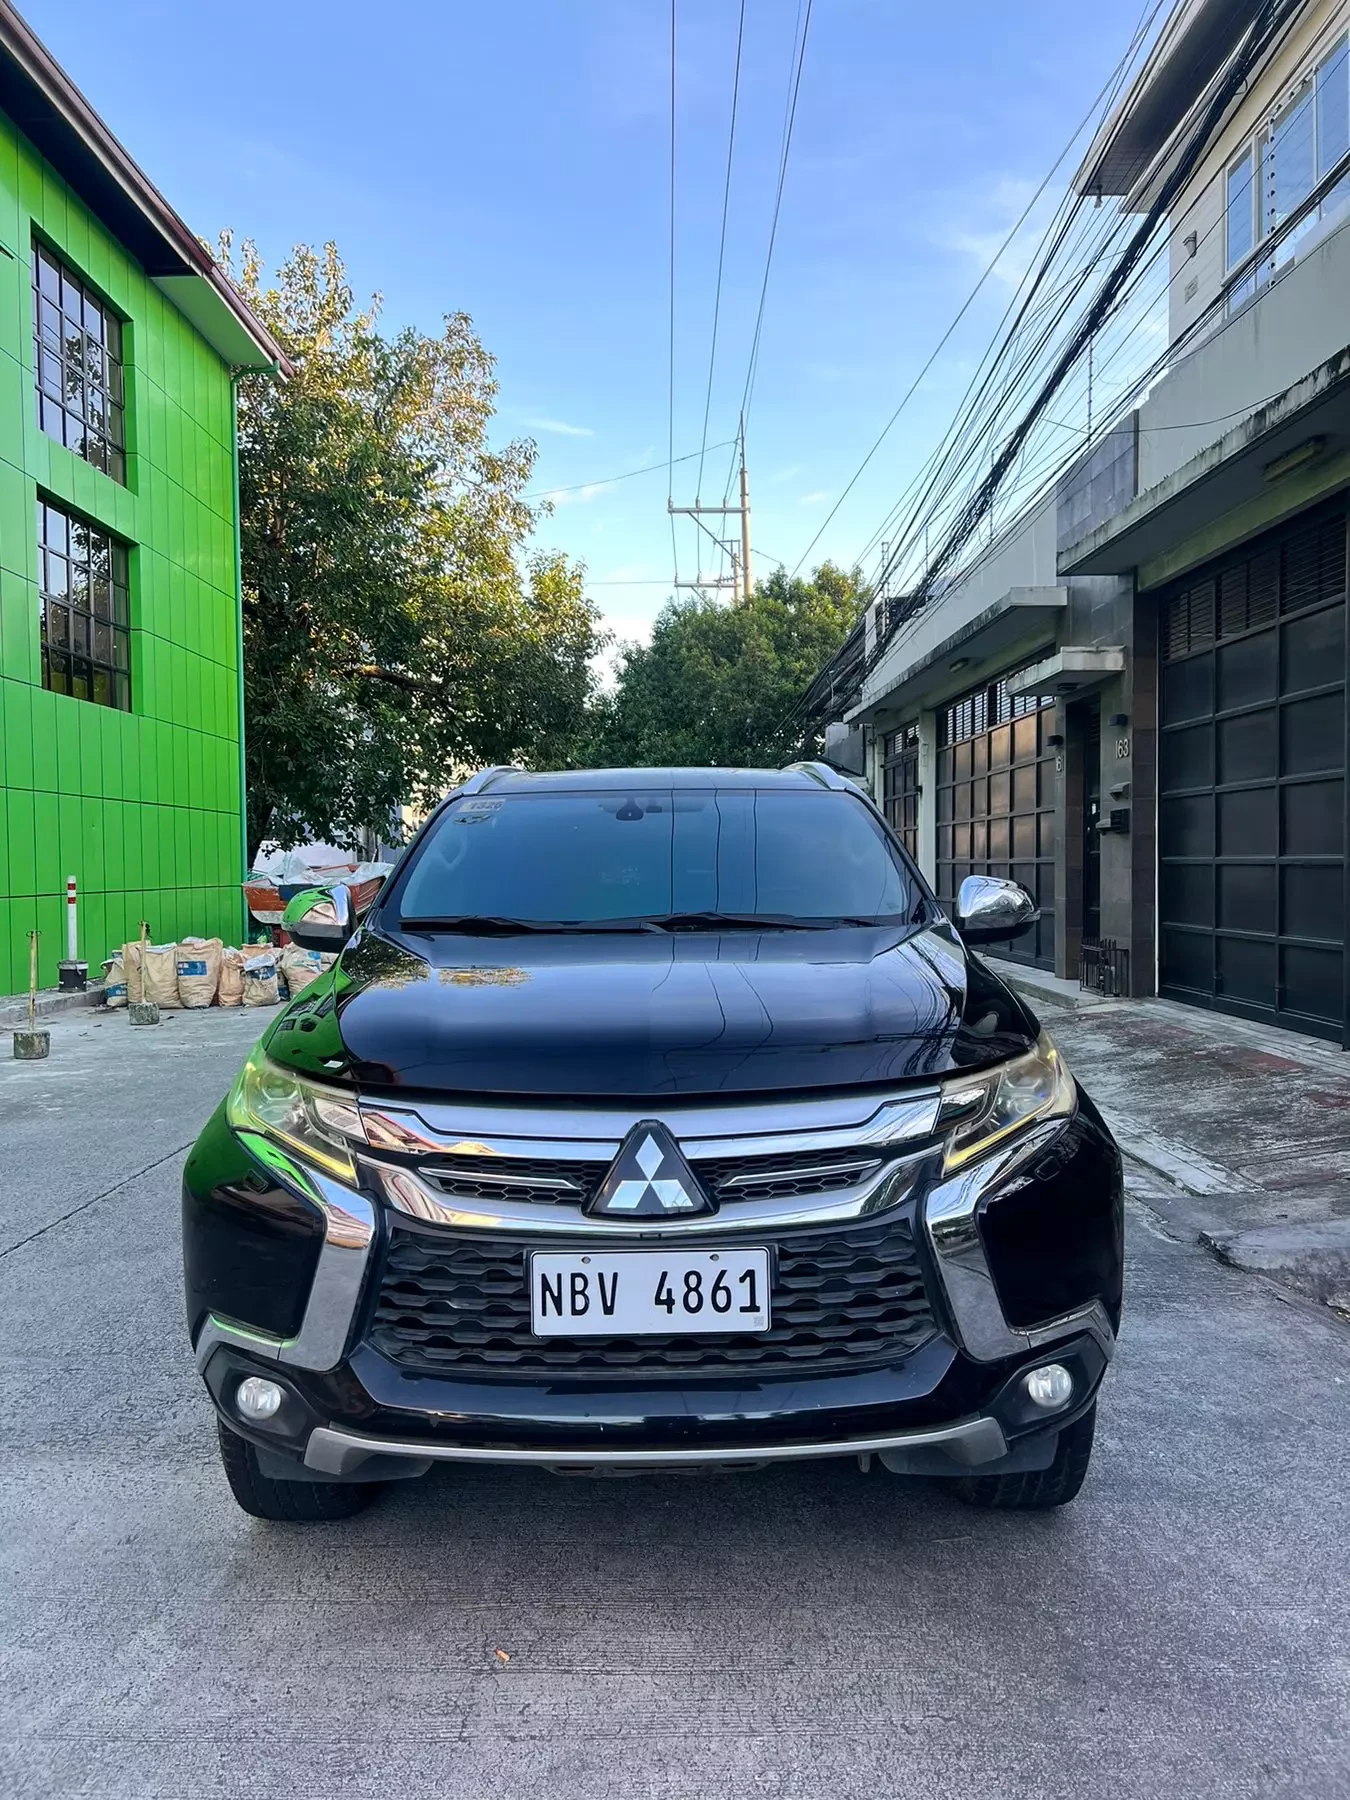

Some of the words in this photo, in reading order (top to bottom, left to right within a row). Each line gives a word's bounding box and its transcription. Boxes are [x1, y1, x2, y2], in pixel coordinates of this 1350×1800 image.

[1115, 738, 1129, 759] 163
[541, 1271, 618, 1317] NBV
[654, 1269, 761, 1314] 4861
